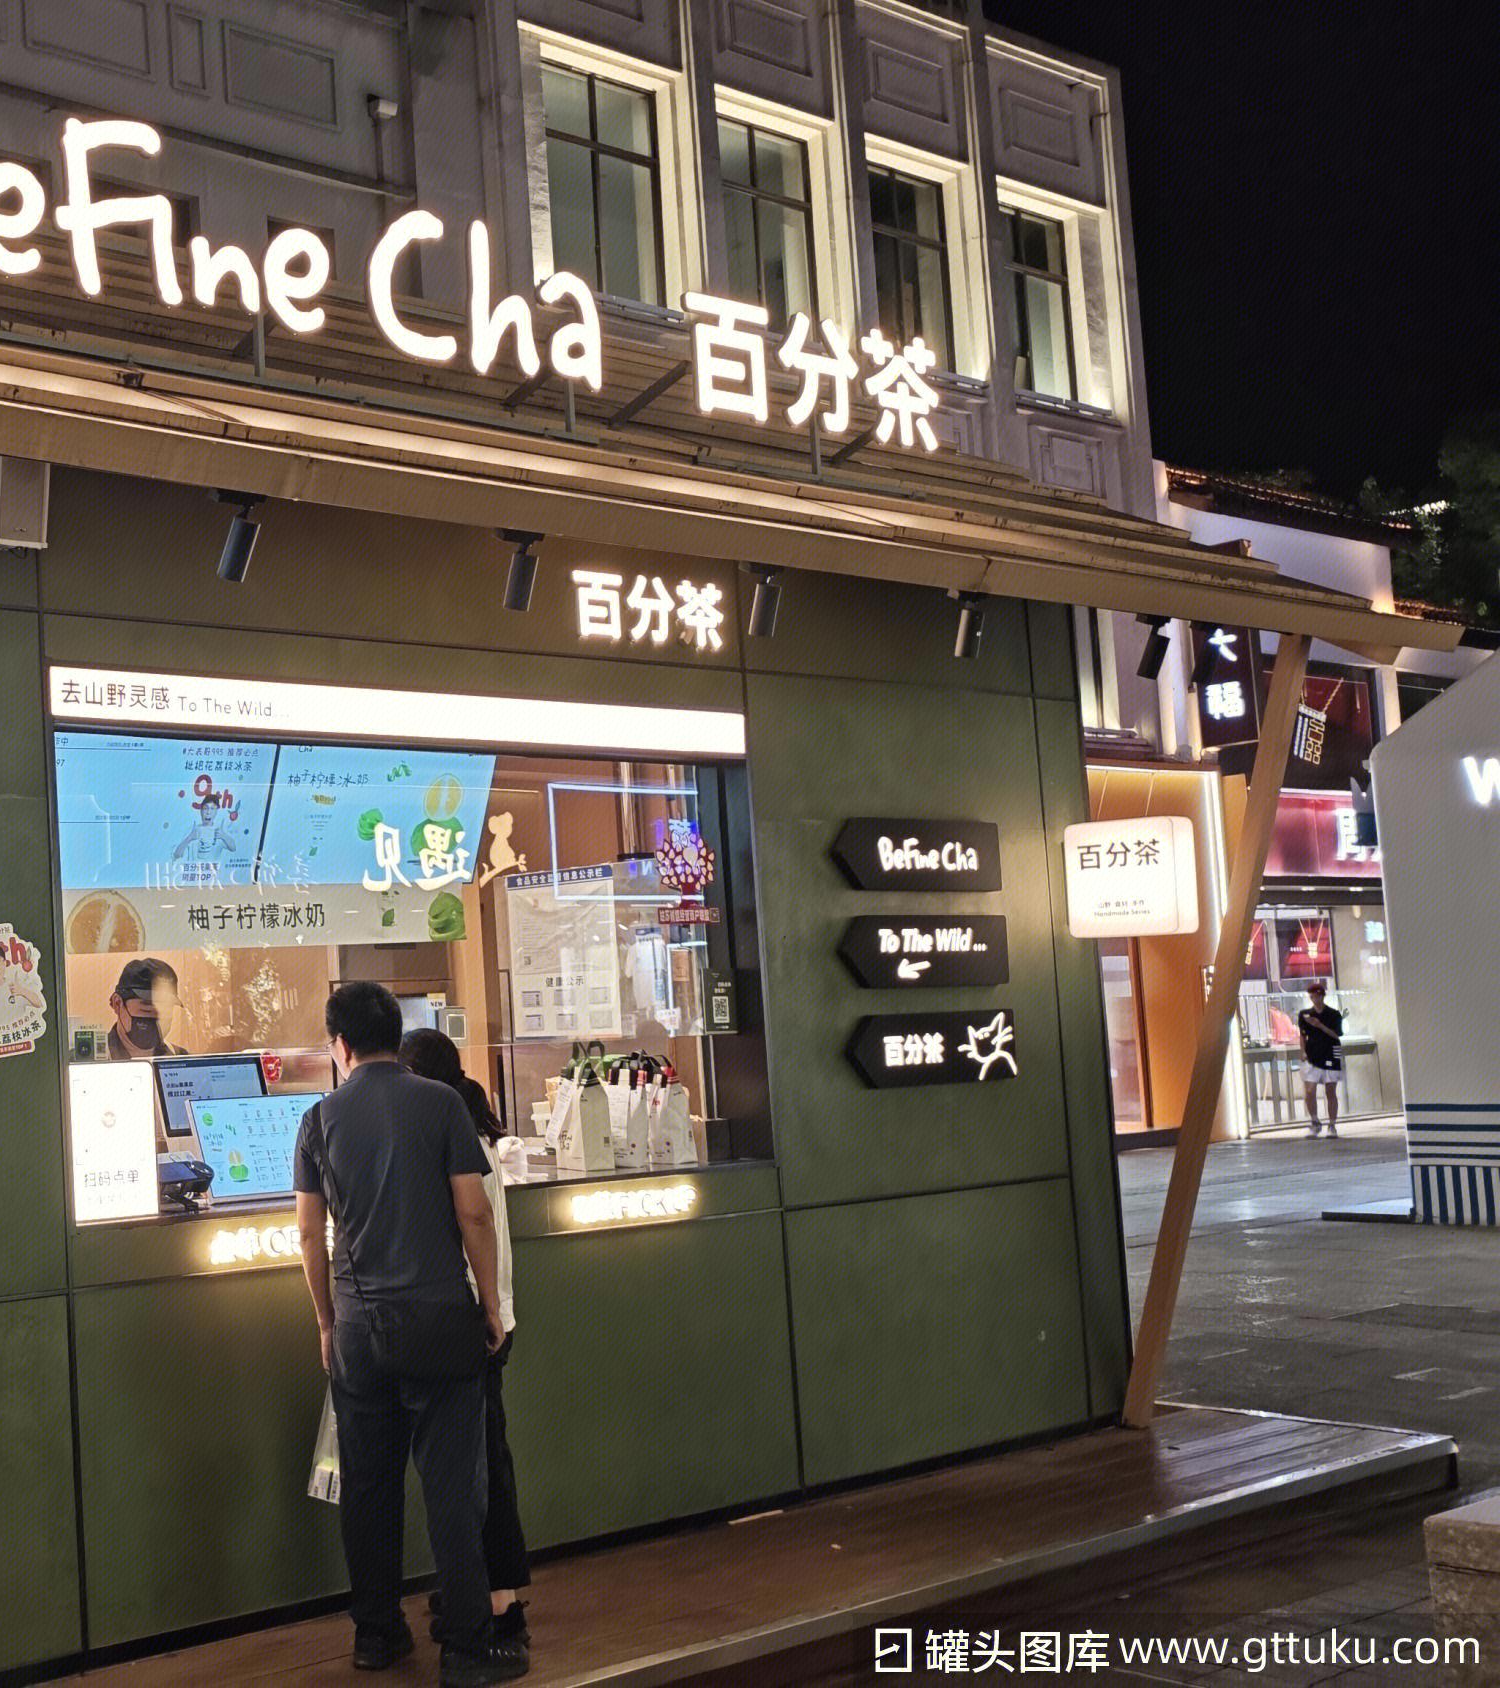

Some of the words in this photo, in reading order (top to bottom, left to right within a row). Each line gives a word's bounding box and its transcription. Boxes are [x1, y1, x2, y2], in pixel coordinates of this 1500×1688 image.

[368, 209, 602, 392] Cha
[683, 290, 940, 452] 百分茶
[572, 568, 726, 651] 百分茶
[61, 680, 171, 710] 去山野灵感
[178, 696, 198, 712] To
[202, 697, 232, 714] The
[876, 836, 941, 873] BeFine
[941, 840, 980, 872] Cha
[1077, 838, 1161, 871] 百分茶
[187, 901, 327, 931] 柚子柠檬冰奶
[878, 928, 900, 954] To
[901, 927, 934, 953] The
[882, 1032, 945, 1067] 百分茶
[84, 1169, 140, 1189] 扫码点单
